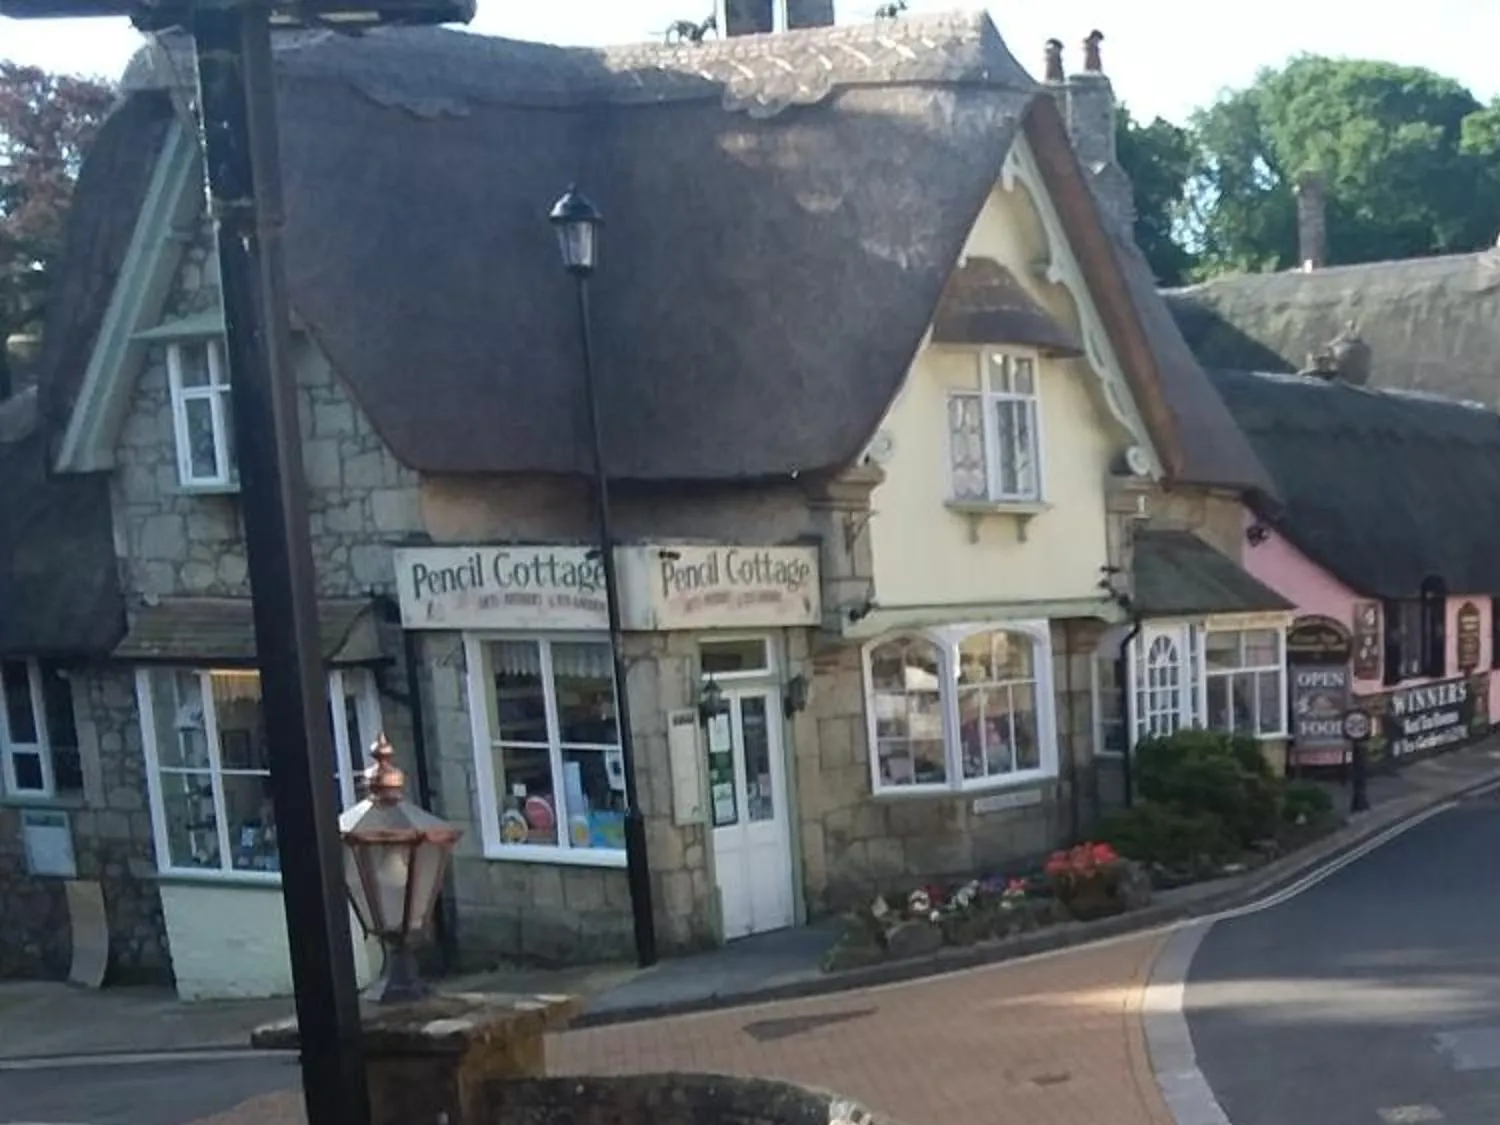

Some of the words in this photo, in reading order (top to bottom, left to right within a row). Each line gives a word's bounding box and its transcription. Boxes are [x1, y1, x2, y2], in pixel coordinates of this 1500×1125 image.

[413, 552, 484, 598] Pencil
[494, 551, 606, 595] Cottage
[661, 551, 719, 600] Pencil
[725, 549, 810, 592] Cottage
[1298, 671, 1345, 687] OPEN
[1392, 682, 1468, 716] WINNERS
